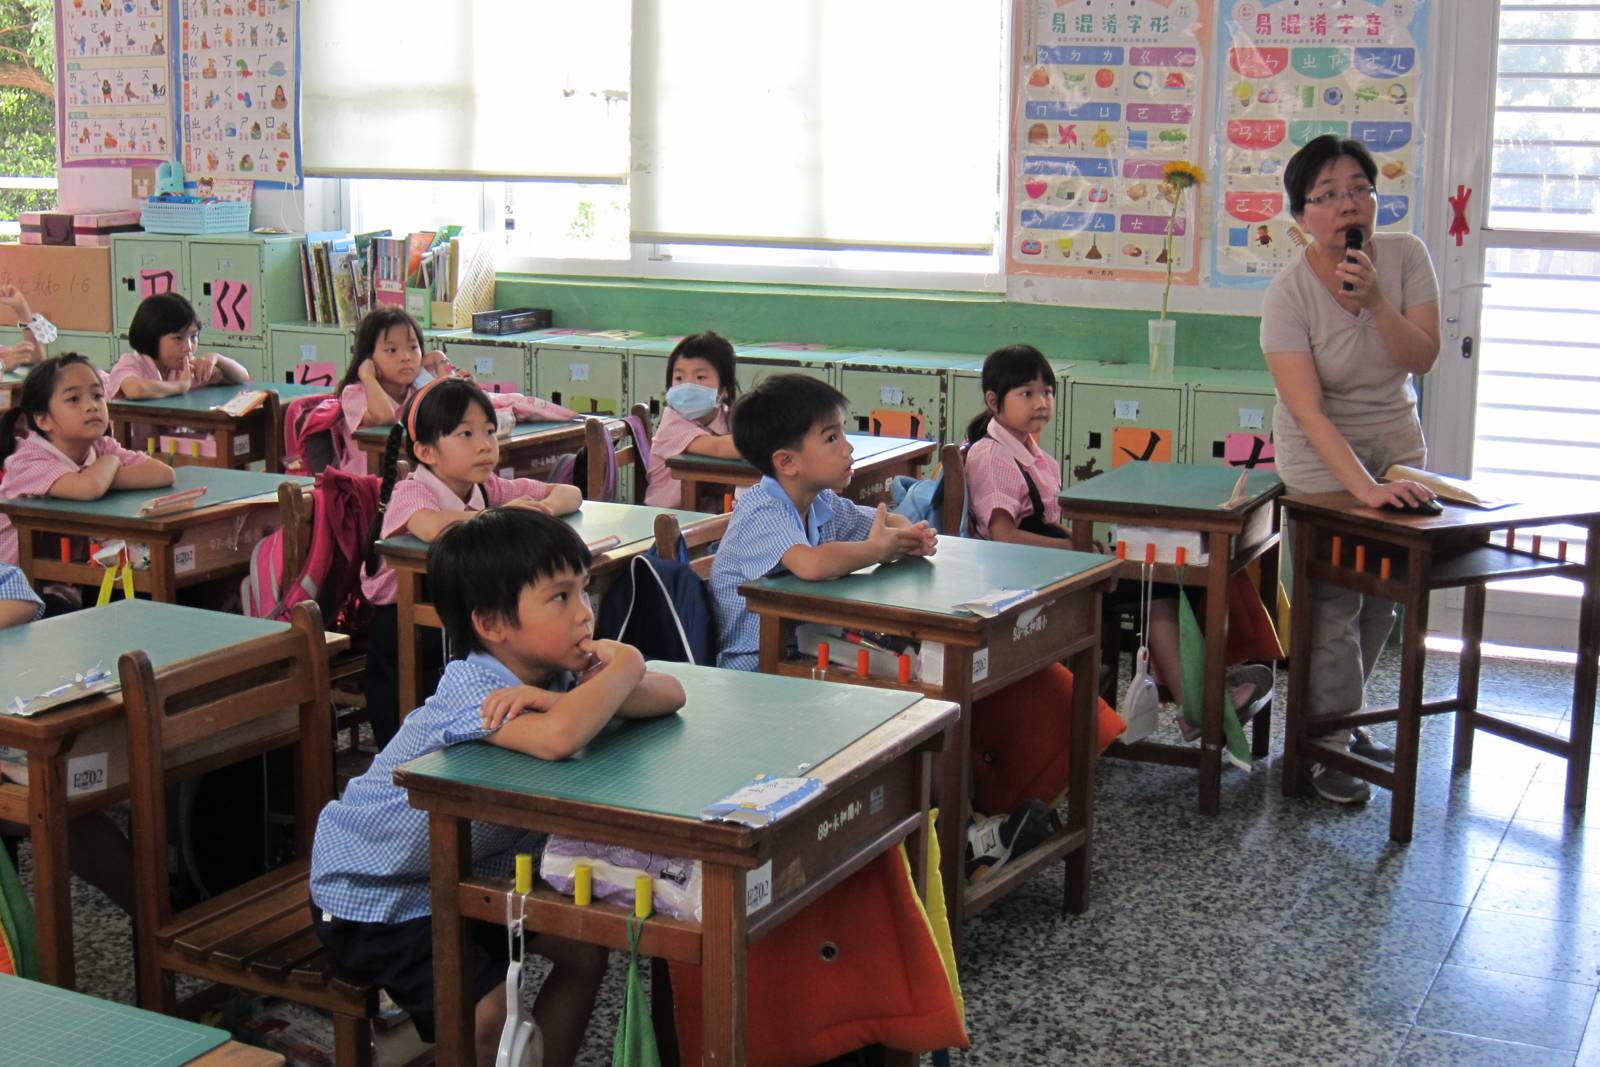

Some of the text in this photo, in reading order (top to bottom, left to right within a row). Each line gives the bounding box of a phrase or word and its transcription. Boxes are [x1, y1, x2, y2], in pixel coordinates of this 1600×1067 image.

[1052, 13, 1169, 34] 易混淆字形
[1256, 13, 1382, 36] 易混淆字音
[73, 768, 104, 789] E202
[747, 879, 769, 906] E202
